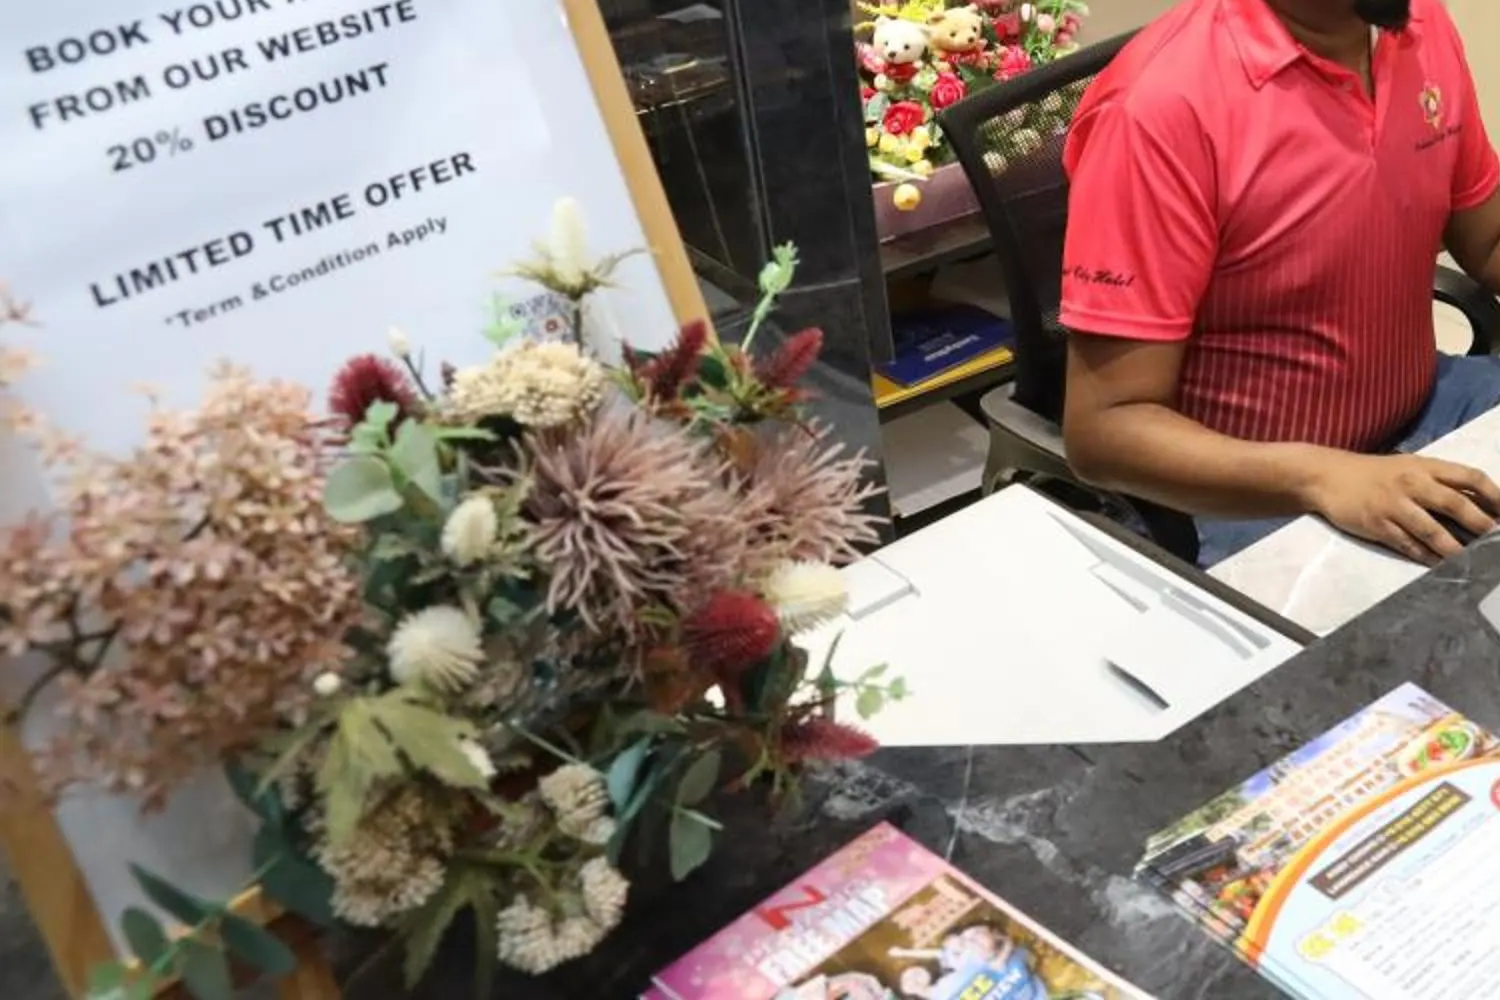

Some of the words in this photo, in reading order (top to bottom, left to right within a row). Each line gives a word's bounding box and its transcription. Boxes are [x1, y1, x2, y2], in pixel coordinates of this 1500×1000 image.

[25, 19, 151, 73] BOOK
[27, 75, 151, 130] FROM
[163, 47, 248, 91] OUR
[107, 126, 193, 171] 20%
[203, 63, 391, 142] DISCOUNT
[88, 229, 255, 307] LIMITED
[263, 194, 356, 245] TIME
[363, 152, 476, 208] OFFER
[385, 214, 449, 257] Apply
[822, 885, 891, 945] MAP
